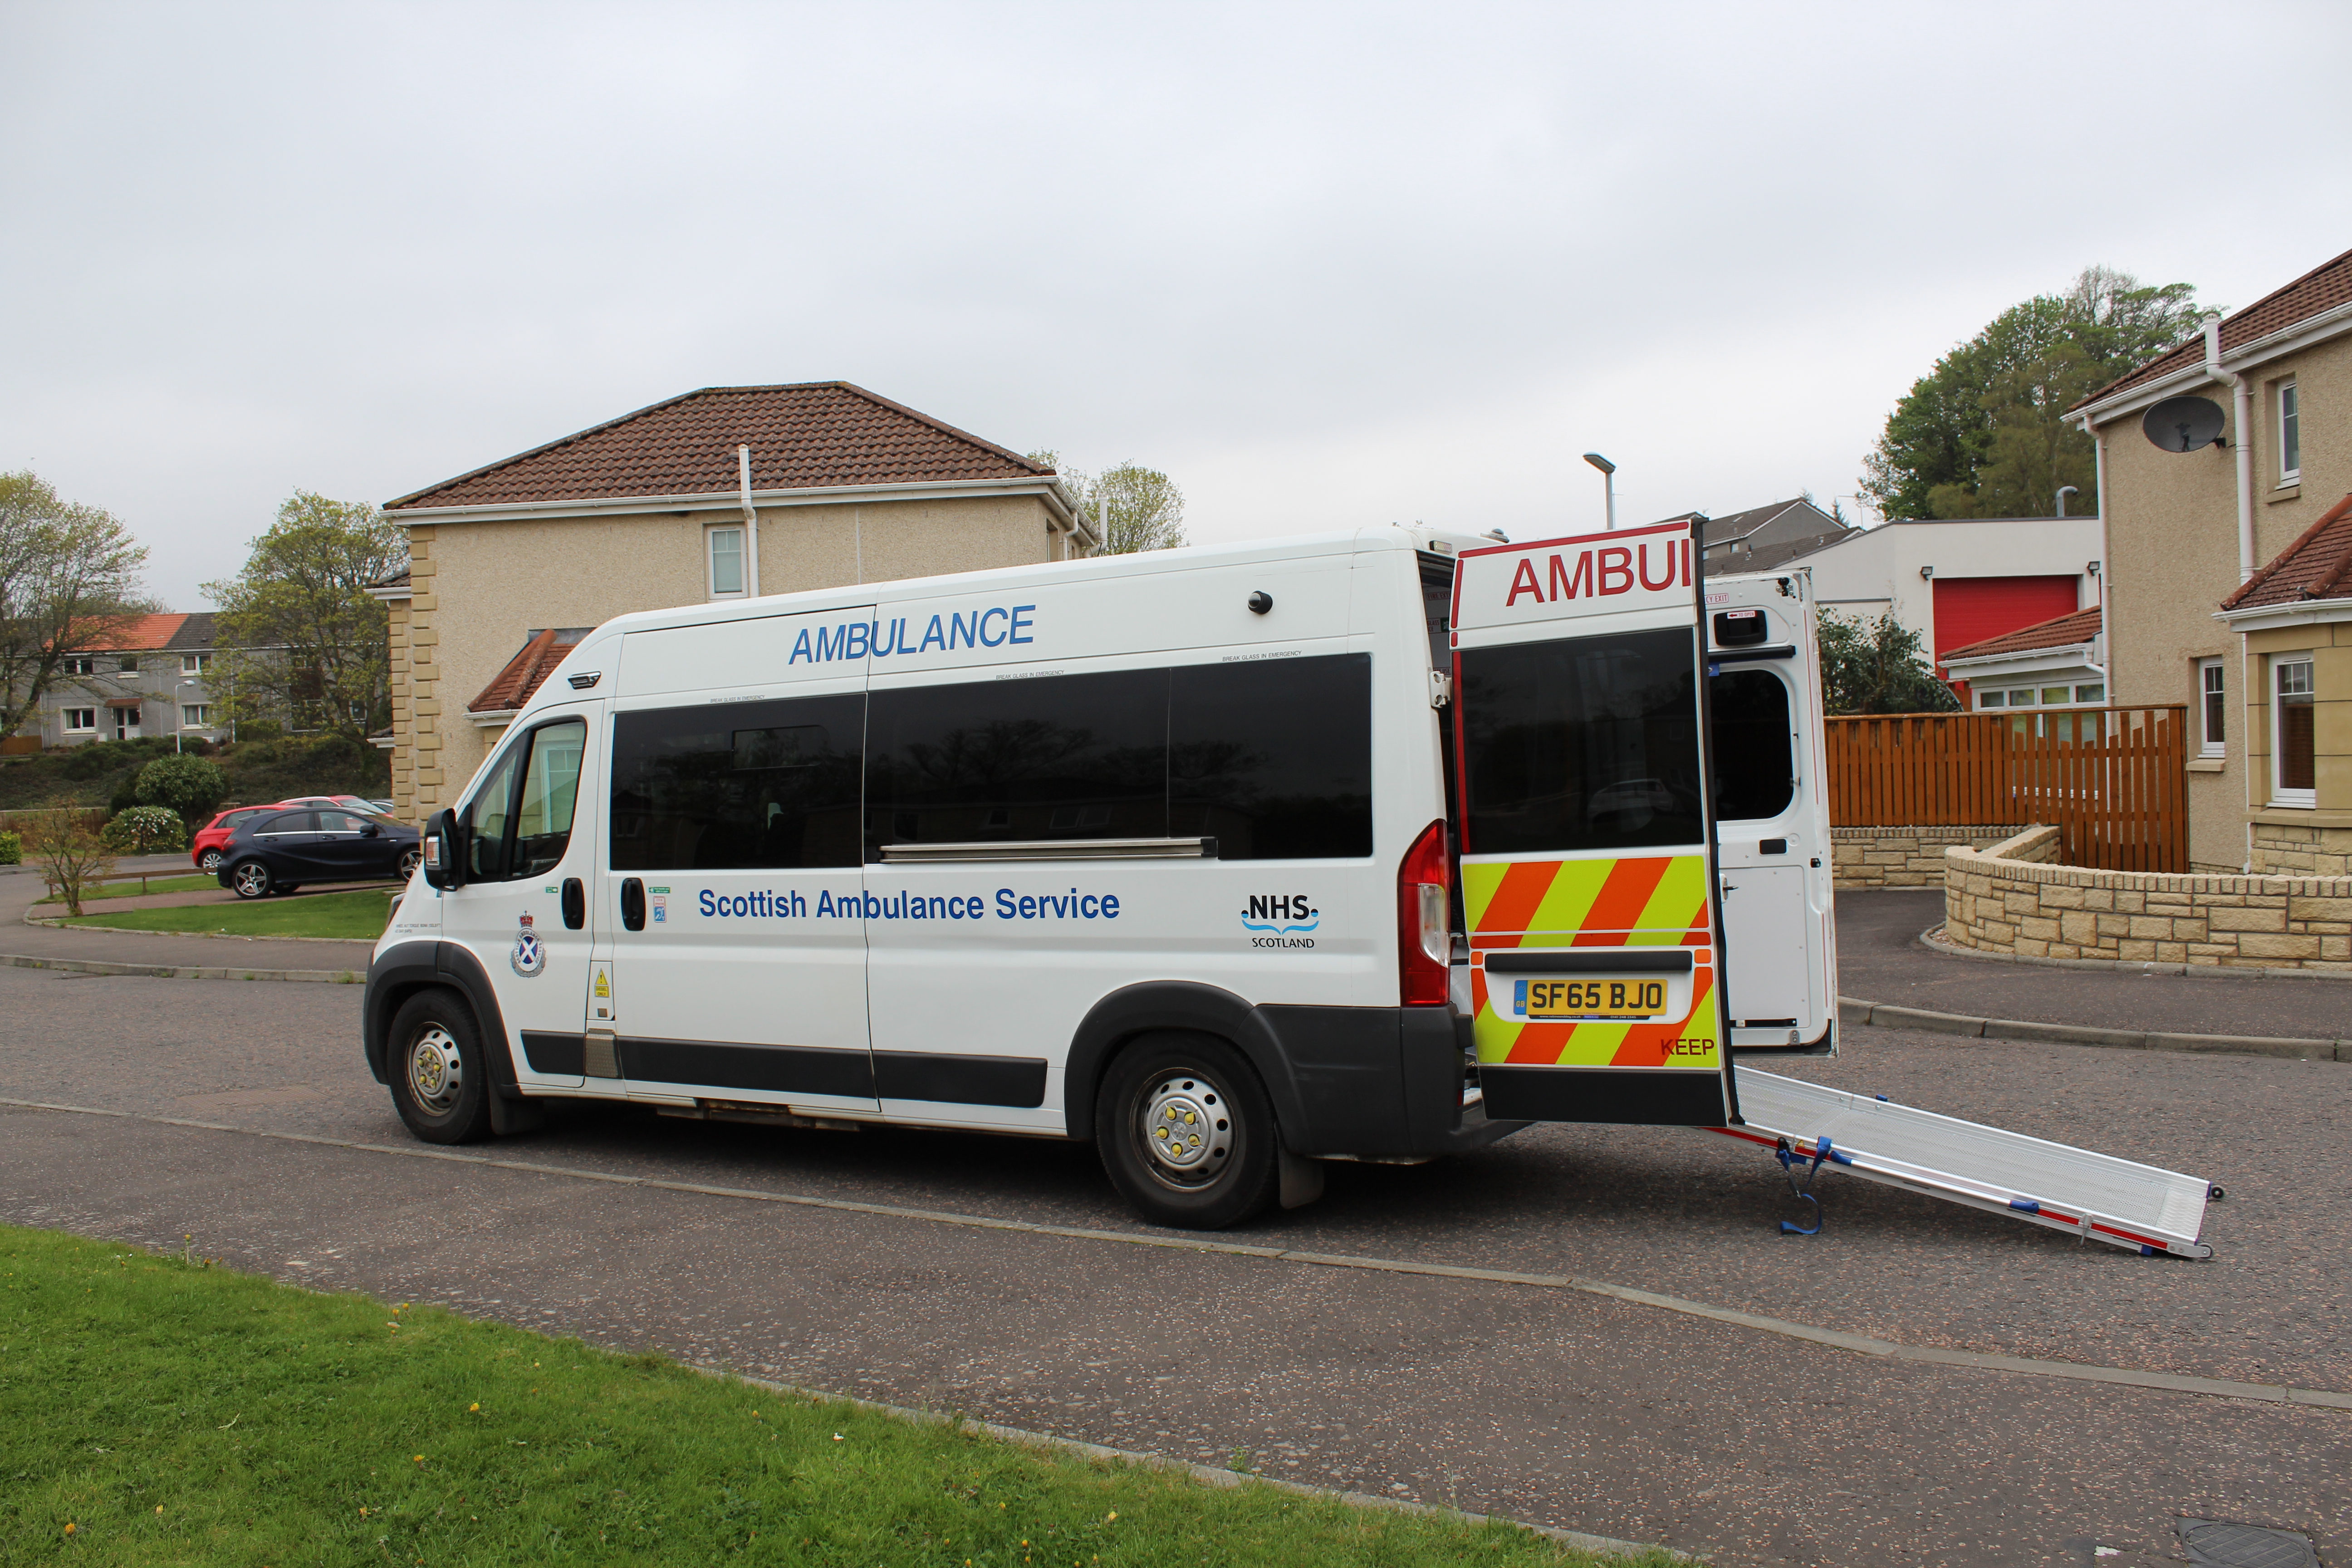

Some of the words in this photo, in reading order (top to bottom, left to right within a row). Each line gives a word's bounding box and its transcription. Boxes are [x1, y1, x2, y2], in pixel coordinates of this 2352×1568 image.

[1715, 594, 1727, 603] EXIT
[788, 604, 1036, 665] AMBULANCE
[699, 889, 806, 917] Scottish
[817, 890, 984, 919] Ambulance
[995, 888, 1120, 919] Service
[1250, 895, 1309, 920] NHS
[1252, 937, 1314, 948] SCOTLAND
[1532, 983, 1601, 1009] SF65
[1609, 983, 1662, 1009] BJO
[1661, 1039, 1715, 1055] KEEP
